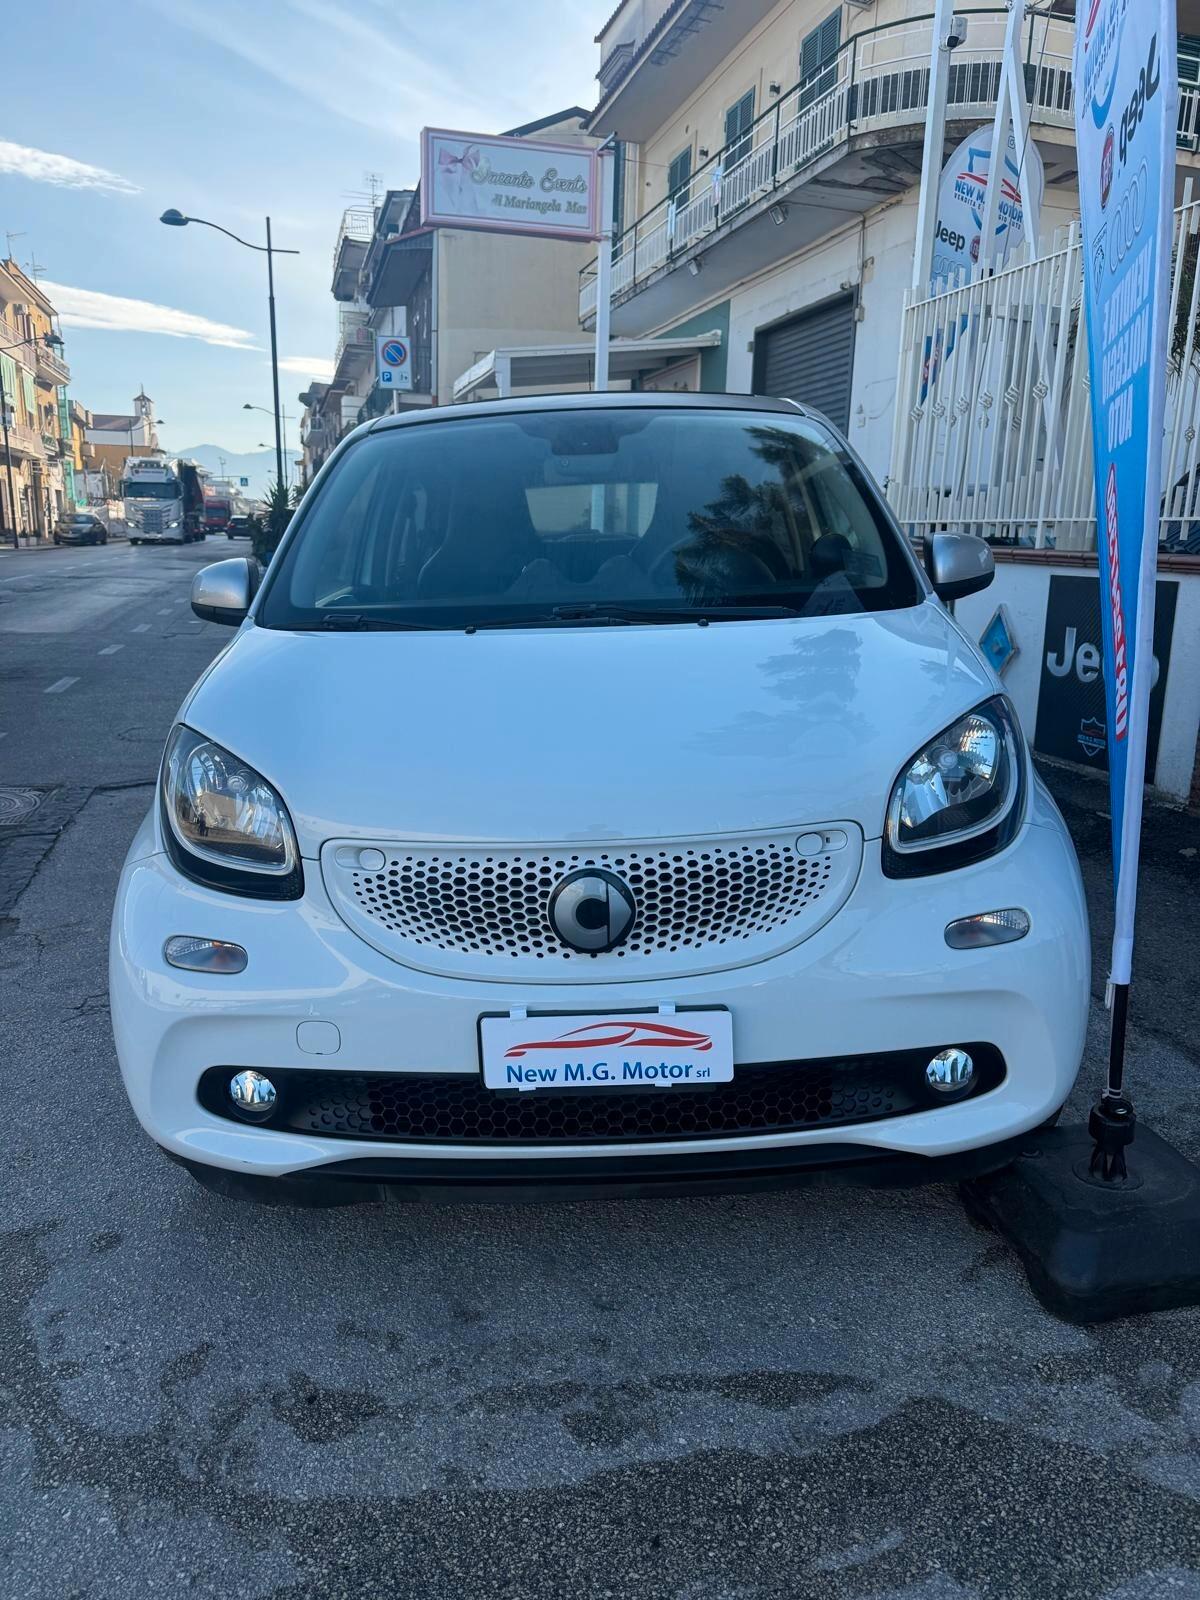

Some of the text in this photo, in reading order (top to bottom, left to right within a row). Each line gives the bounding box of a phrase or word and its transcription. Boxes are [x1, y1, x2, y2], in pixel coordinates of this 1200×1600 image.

[540, 168, 587, 193] Events
[955, 180, 975, 198] NEW
[504, 195, 562, 214] Mariangela
[935, 220, 966, 252] Jeep
[506, 1060, 711, 1083] New M.G. Motor srl
